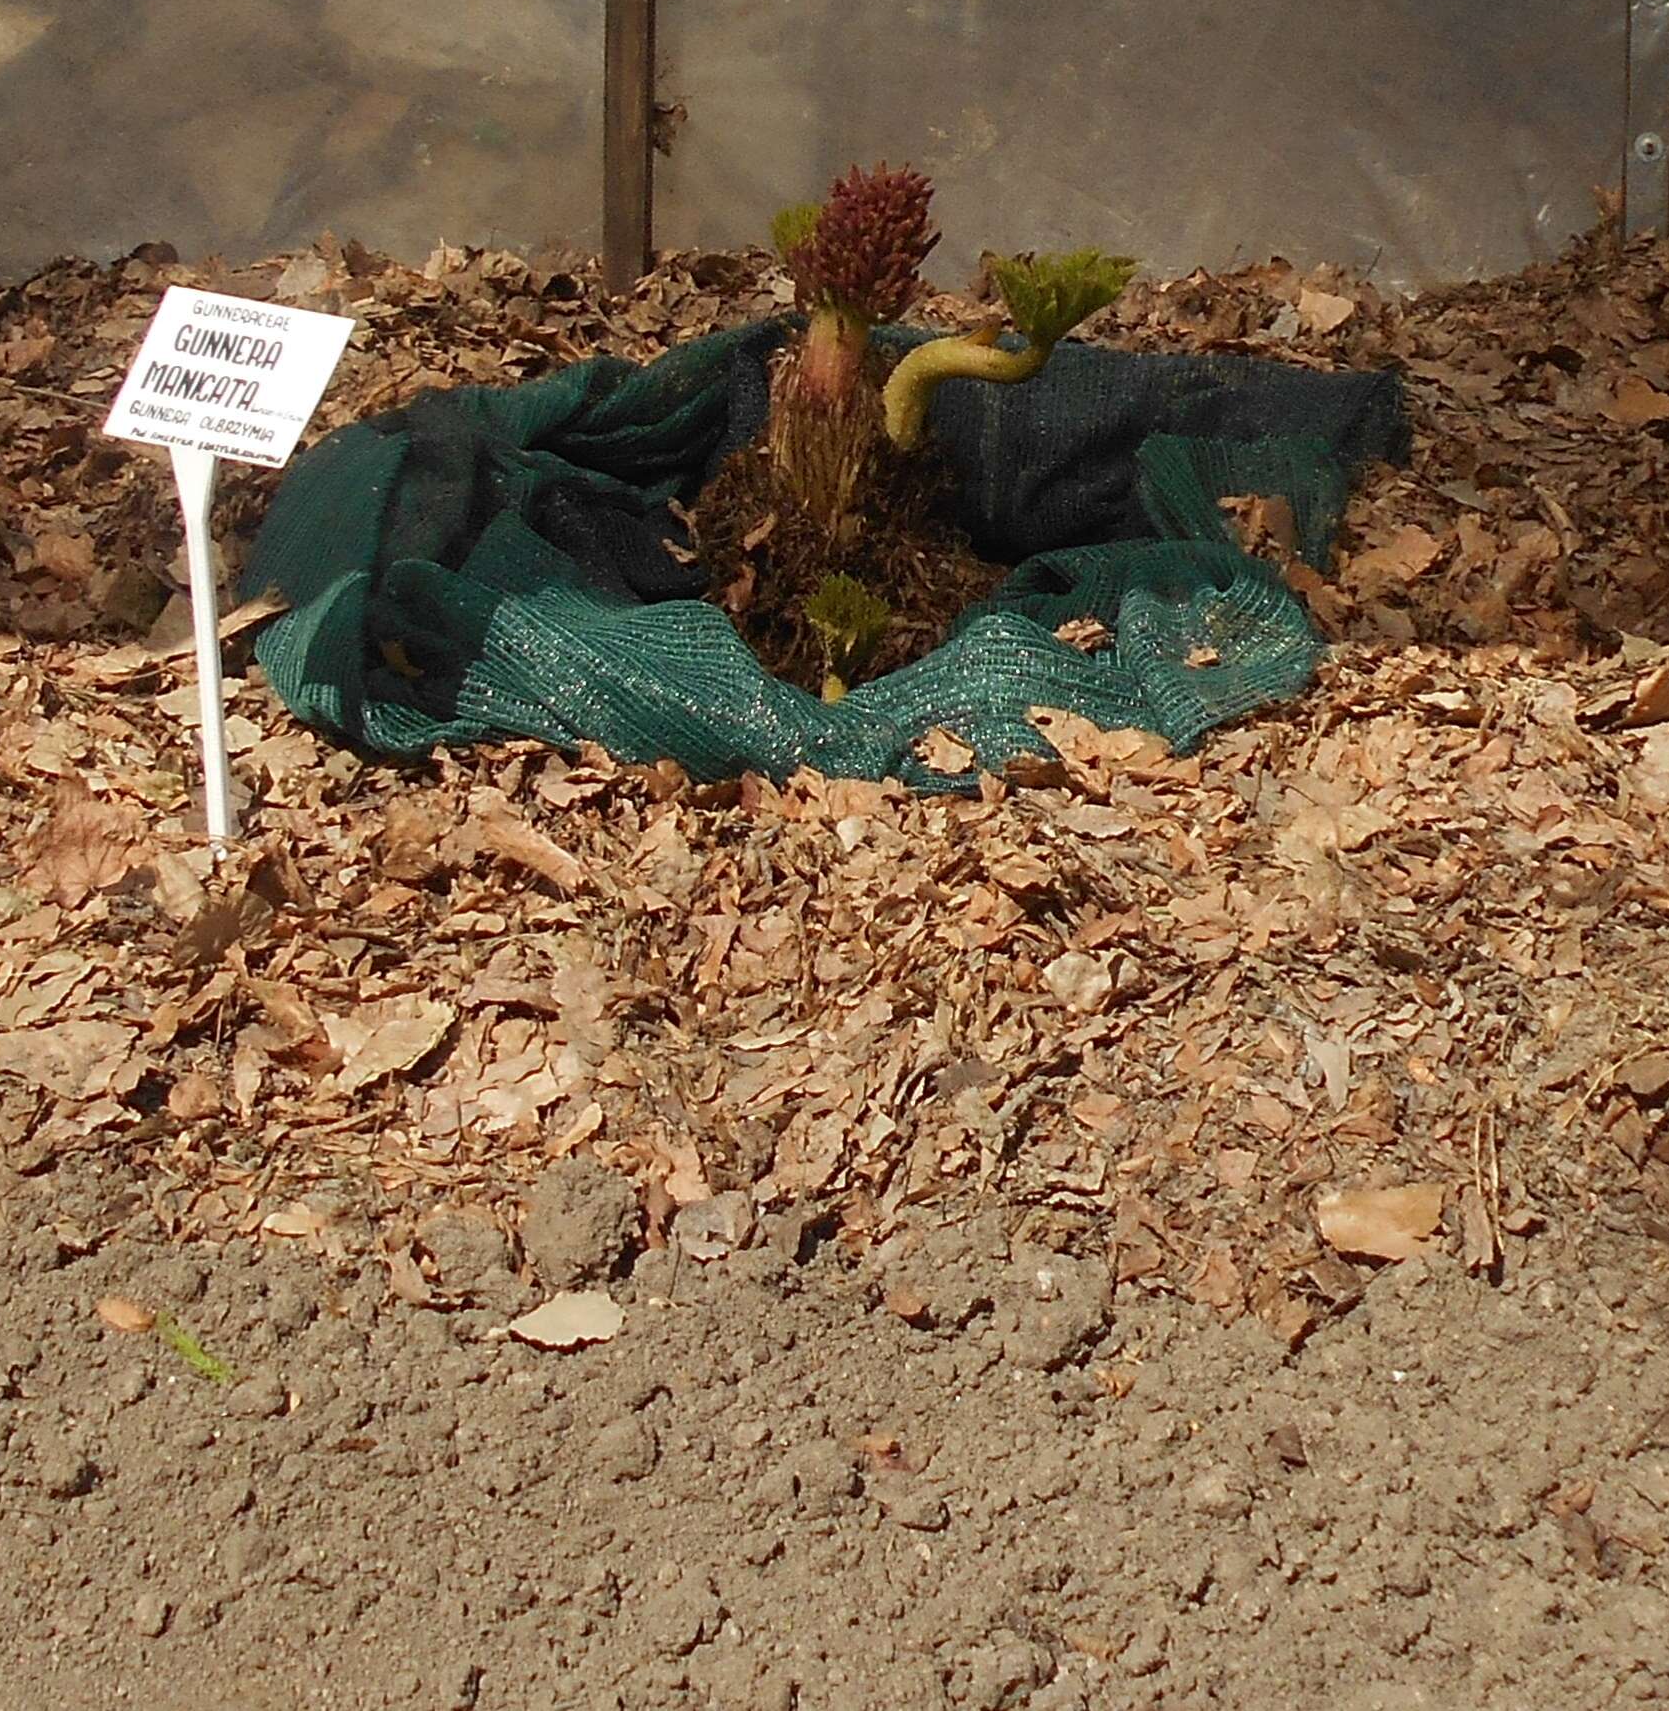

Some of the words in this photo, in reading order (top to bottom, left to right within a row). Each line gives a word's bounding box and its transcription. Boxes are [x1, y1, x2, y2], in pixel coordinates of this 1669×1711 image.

[193, 300, 291, 331] GUNNERACEAE
[174, 324, 283, 369] GUNNERA
[141, 360, 259, 412] MANICATA
[130, 400, 192, 426] GUNNERA
[199, 415, 275, 443] OLBRZYMIA
